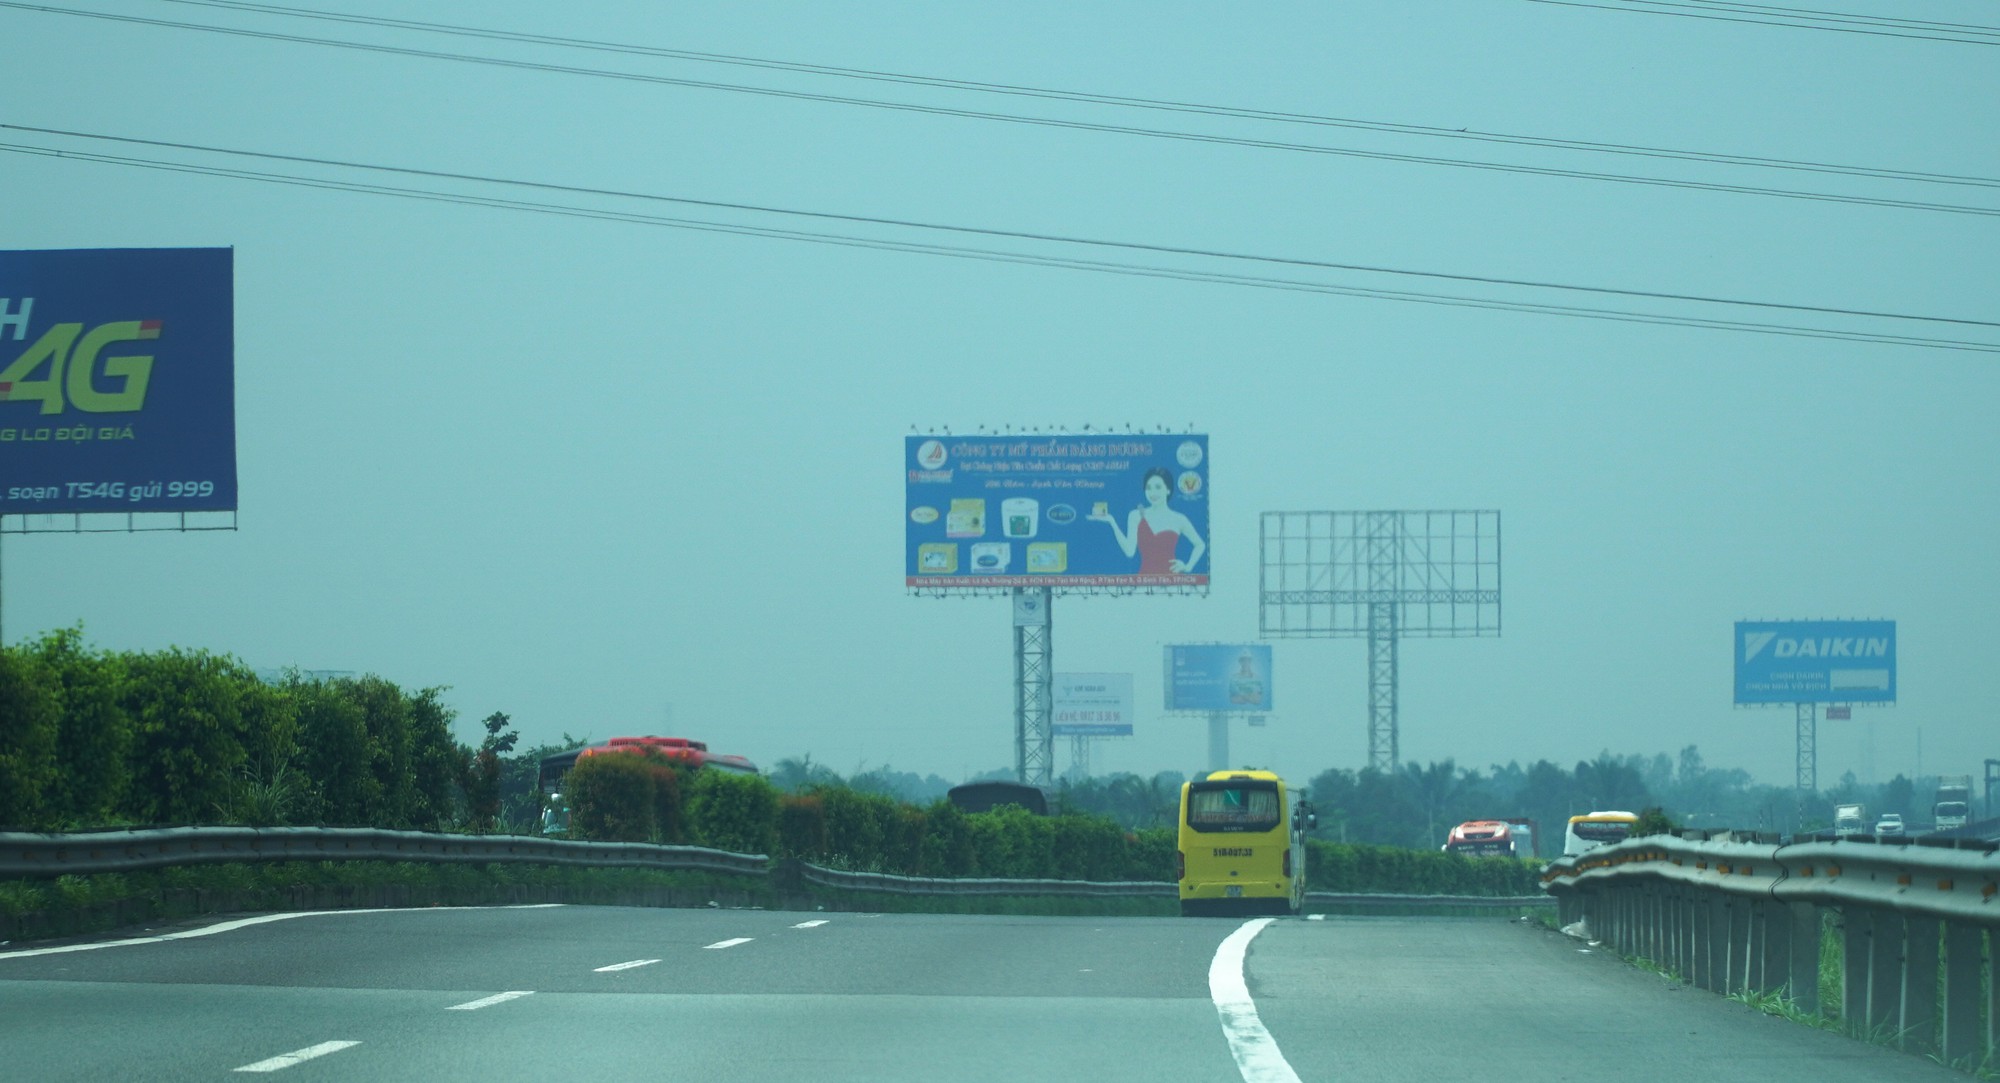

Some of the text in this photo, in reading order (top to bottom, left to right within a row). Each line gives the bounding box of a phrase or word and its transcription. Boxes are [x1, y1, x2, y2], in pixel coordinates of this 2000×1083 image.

[0, 320, 163, 415] 4G
[21, 428, 50, 441] LO
[55, 424, 93, 444] ĐỘI
[98, 423, 135, 440] GIÁ
[951, 441, 987, 457] CÔNG
[990, 444, 1006, 457] TY
[8, 480, 214, 502] soạn TS4G gửi 999
[1774, 638, 1887, 658] DAIKIN
